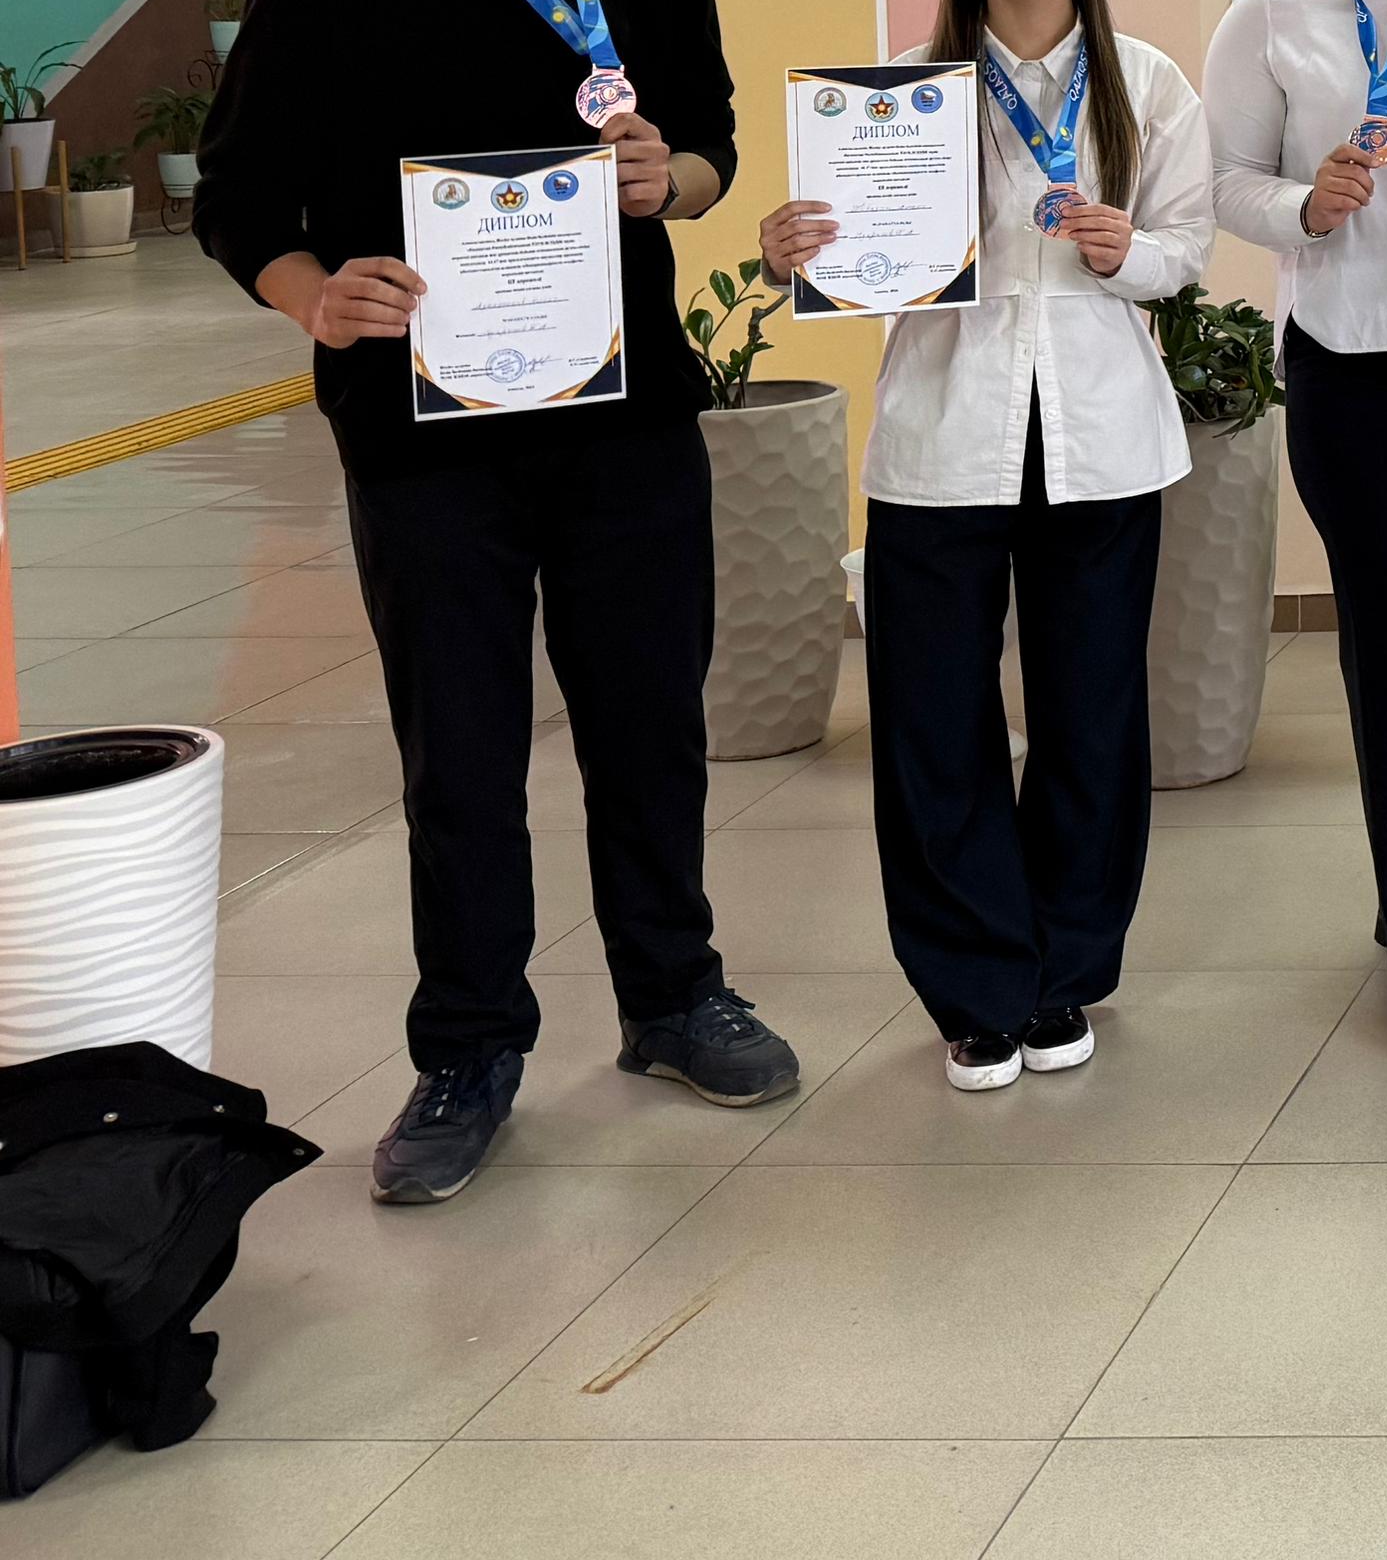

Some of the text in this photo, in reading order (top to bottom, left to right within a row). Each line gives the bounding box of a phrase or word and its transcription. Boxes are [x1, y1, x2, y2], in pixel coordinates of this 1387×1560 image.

[983, 61, 1018, 110] QAZAQS
[852, 124, 920, 141] ДИПЛОМ
[477, 212, 554, 235] ДИПЛОМ
